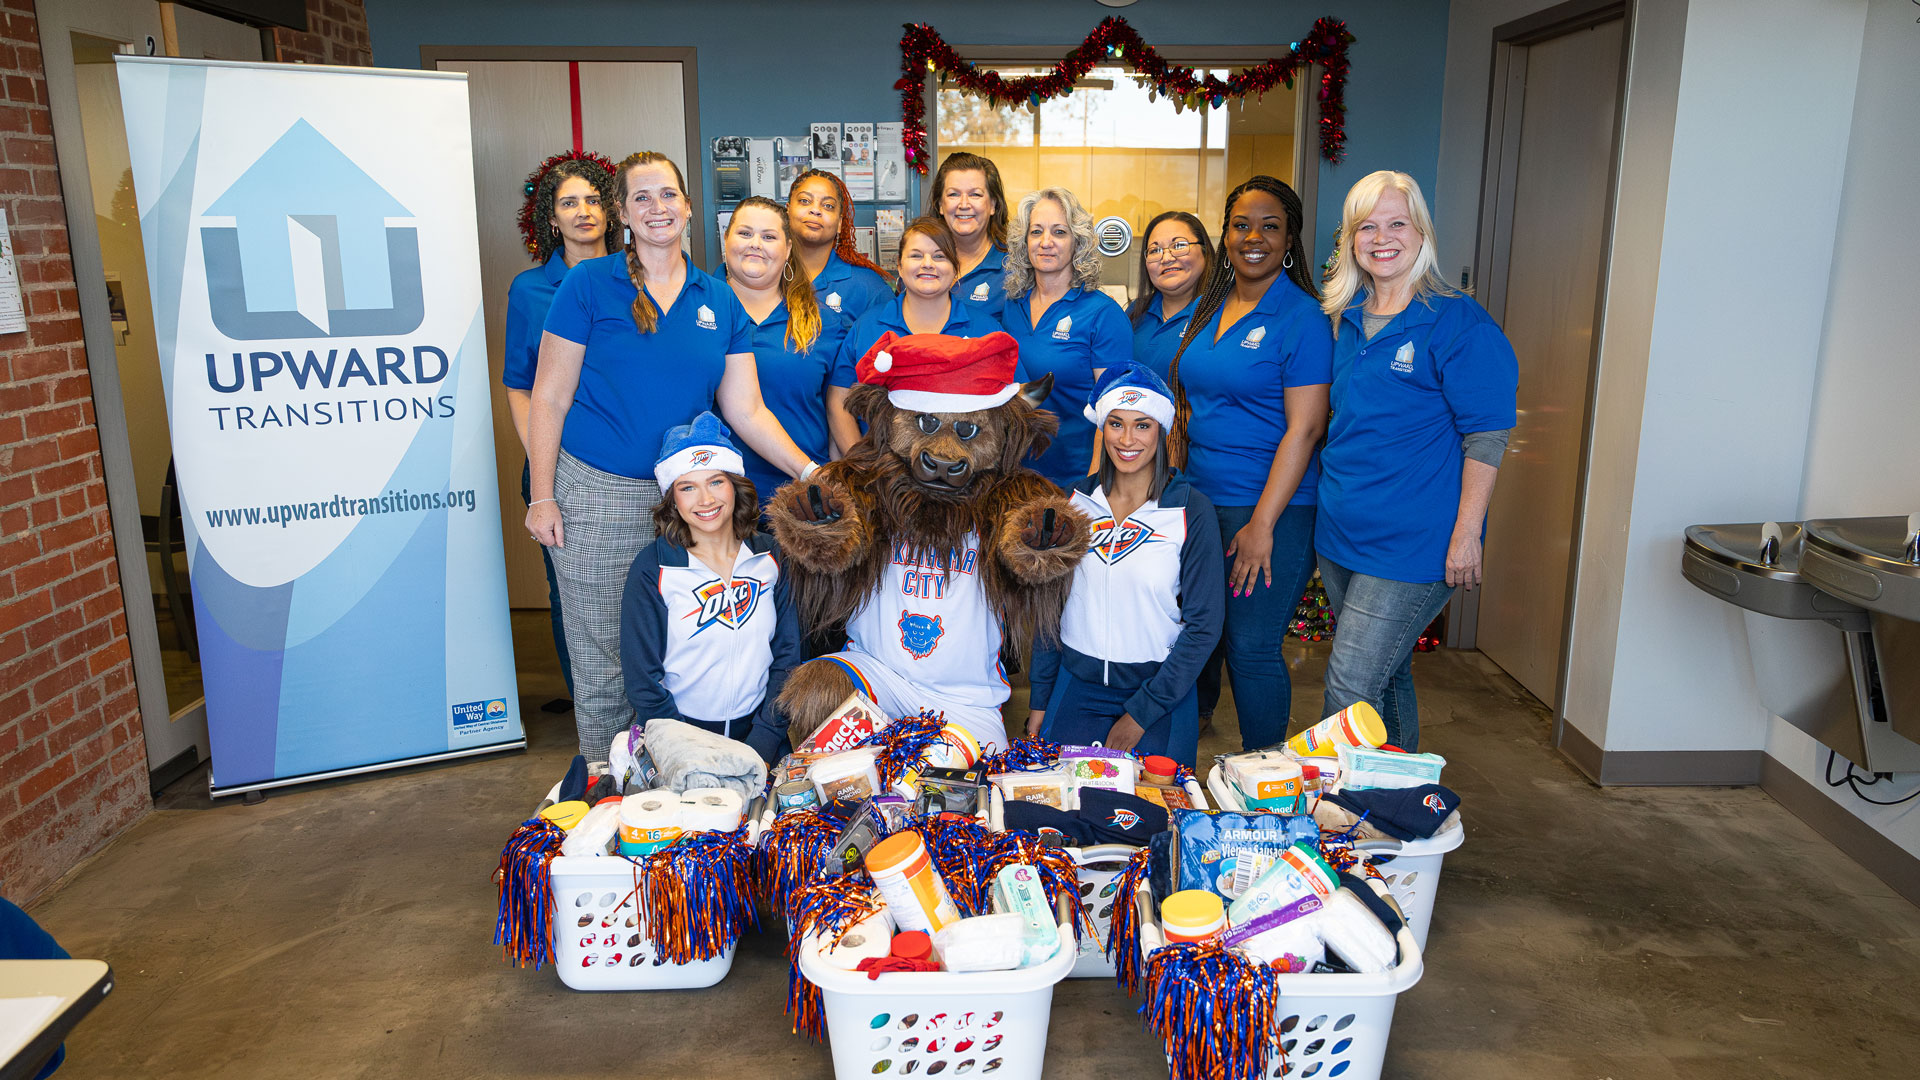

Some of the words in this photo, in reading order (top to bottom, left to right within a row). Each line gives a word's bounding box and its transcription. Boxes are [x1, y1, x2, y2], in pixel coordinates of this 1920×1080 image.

[205, 345, 449, 394] UPWARD
[1390, 361, 1414, 370] UPWARD
[208, 395, 456, 431] TRANSITIONS
[205, 488, 476, 528] www.upwardtransitions.org
[902, 569, 945, 599] CITY
[454, 703, 484, 714] United
[465, 712, 484, 721] Way
[837, 785, 855, 797] RAIN
[1263, 784, 1271, 793] 4
[1284, 781, 1295, 791] 16
[1025, 792, 1045, 802] RAIN
[631, 829, 638, 837] 4
[647, 830, 661, 841] 16
[1223, 830, 1277, 841] ARMOUR
[1224, 930, 1233, 940] 10
